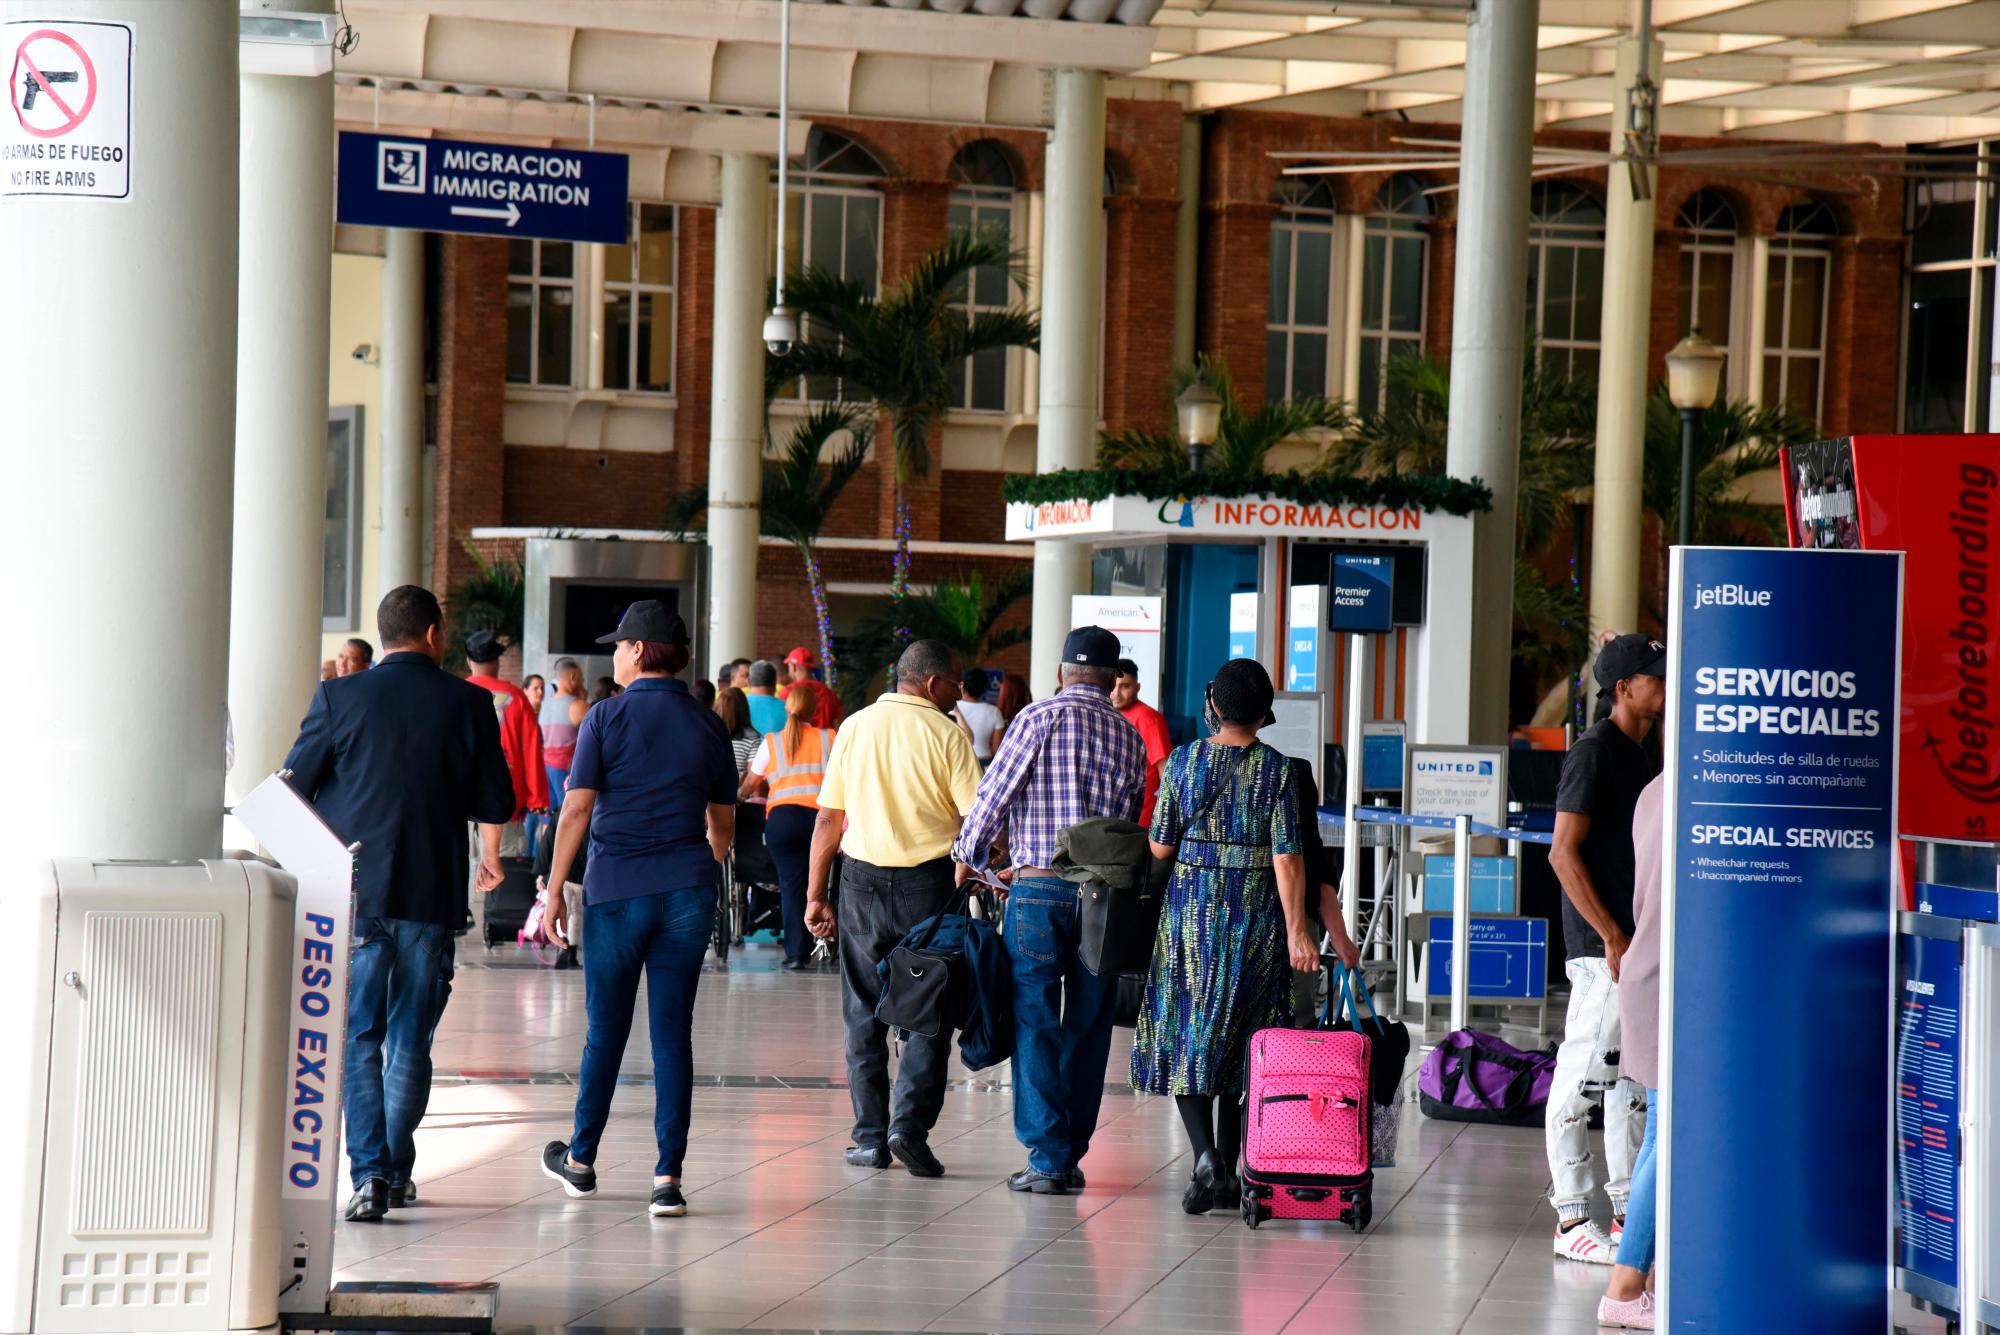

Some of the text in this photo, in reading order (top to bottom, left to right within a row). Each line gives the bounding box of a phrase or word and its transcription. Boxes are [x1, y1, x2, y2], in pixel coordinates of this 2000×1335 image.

[11, 144, 45, 159] ARMAS
[49, 144, 66, 160] DE
[71, 145, 123, 162] FUEGO
[443, 149, 581, 179] MIGRACION
[11, 171, 96, 187] NO FIRE ARMS
[433, 175, 590, 206] IMMIGRATION
[1215, 502, 1420, 530] INFORMACION
[1345, 557, 1372, 565] UNITED
[1334, 596, 1364, 607] Access
[1335, 586, 1371, 597] Premier
[1693, 584, 1771, 610] jetBlue
[1098, 608, 1138, 617] American
[1949, 463, 1997, 776] beforeboarding
[1694, 666, 1857, 699] SERVICIOS
[1695, 703, 1880, 737] ESPECIALES
[1417, 762, 1475, 773] UNITED
[1703, 749, 1880, 769] Solicitudes de silla de ruedas
[1703, 769, 1867, 790] Menores sin acompañante
[1416, 786, 1489, 798] Check the size of
[1416, 797, 1476, 807] your carry-on
[1691, 824, 1875, 850] SPECIAL SERVICES
[1697, 857, 1790, 871] Wheelchair requests
[1697, 870, 1803, 884] Unaccompanied minors
[301, 912, 335, 1018] PESO
[289, 1028, 328, 1189] EXACTO
